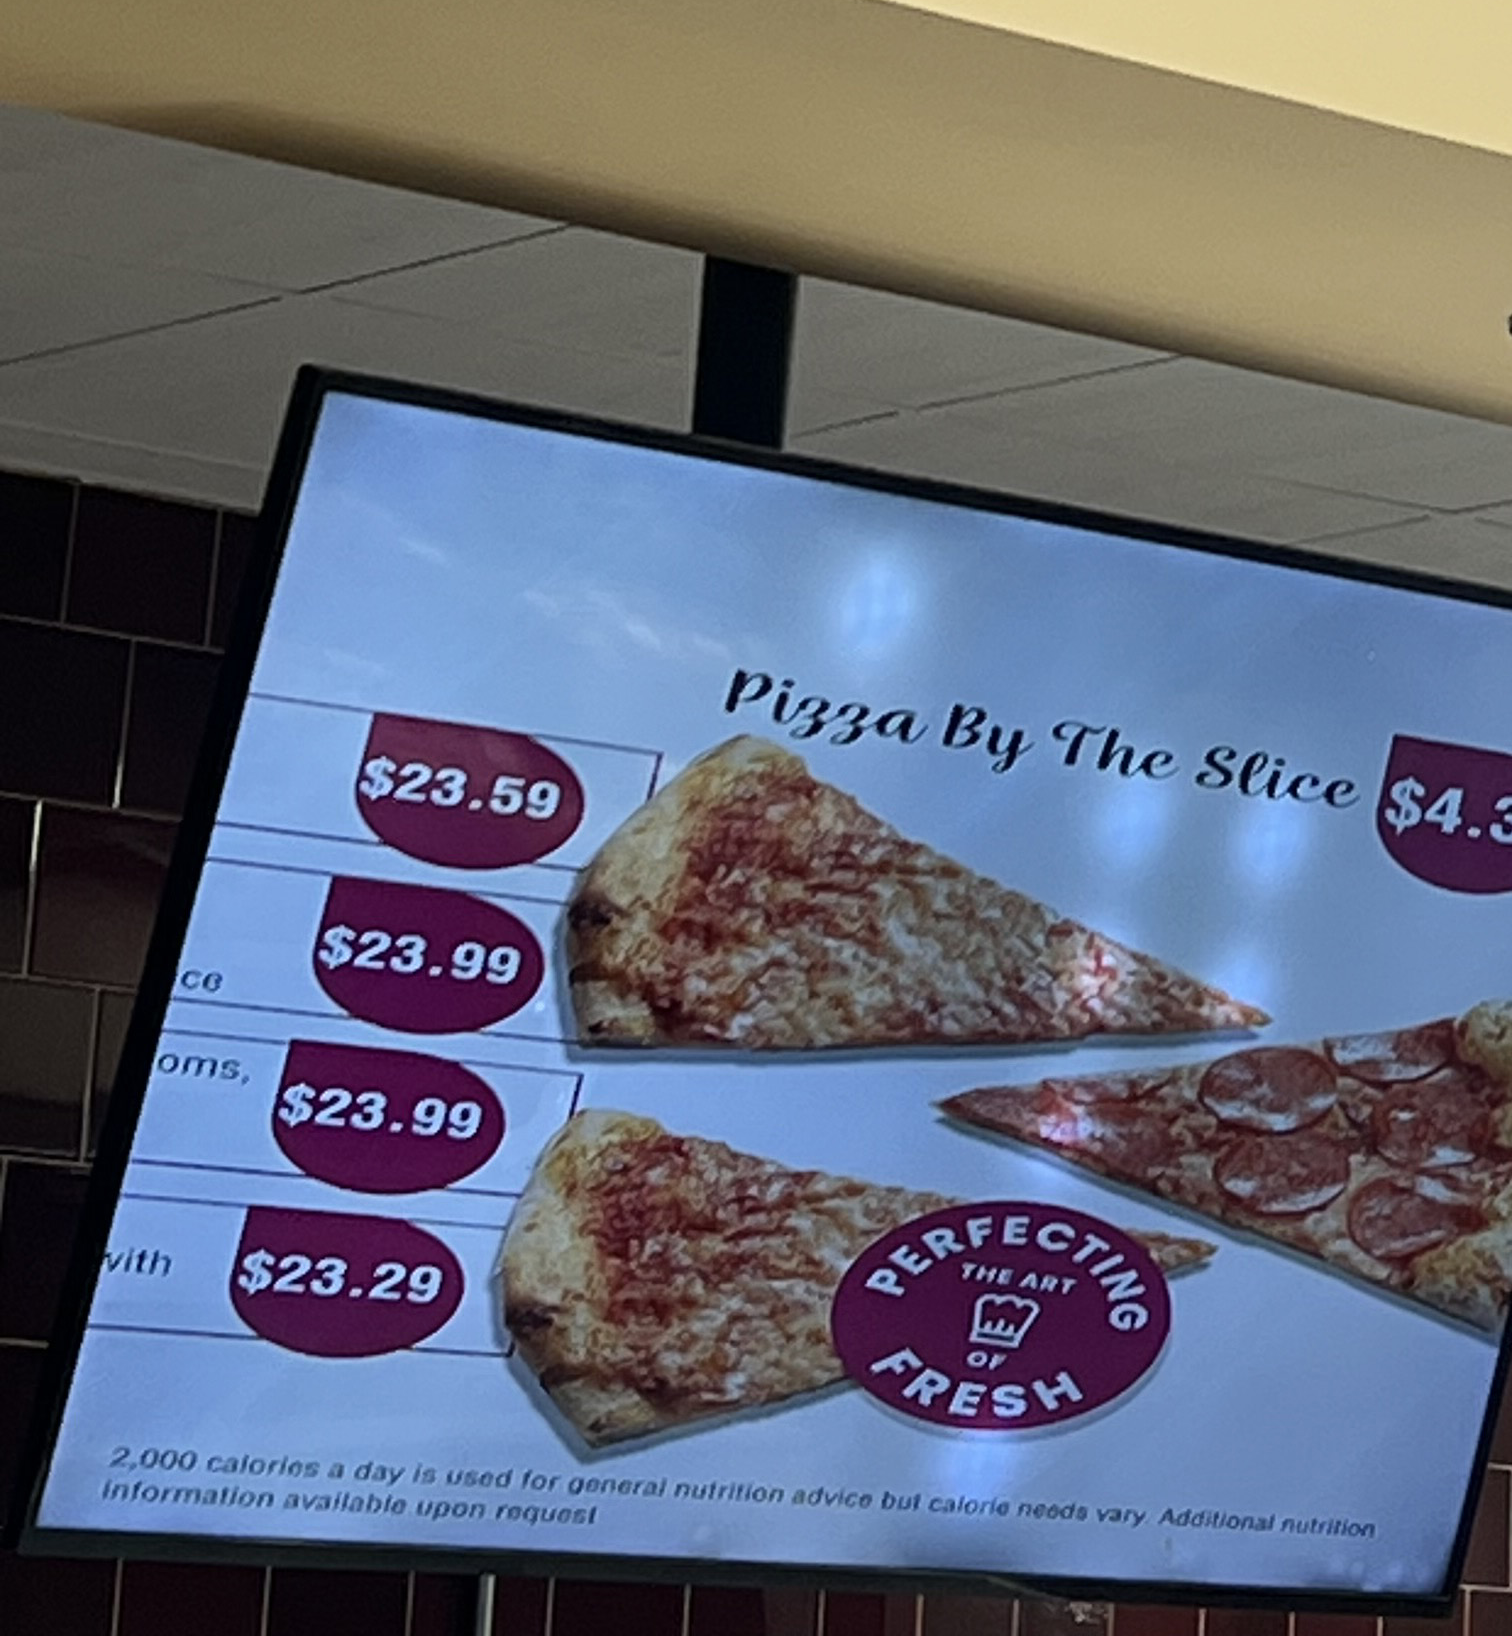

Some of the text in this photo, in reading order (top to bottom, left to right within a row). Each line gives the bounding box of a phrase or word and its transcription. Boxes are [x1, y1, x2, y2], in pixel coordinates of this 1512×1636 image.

[724, 668, 1361, 809] Pizza By The Slice
[359, 755, 561, 821] $23.59
[318, 924, 522, 986] $23.99
[277, 1082, 483, 1141] $23.99
[237, 1249, 444, 1304] $23.29
[864, 1215, 1149, 1332] PERFECTING
[961, 1262, 1078, 1295] THE ART
[870, 1347, 1084, 1418] FRESH
[966, 1351, 1006, 1371] OF
[102, 1478, 598, 1528] information available upon request
[109, 1446, 199, 1472] 2,000
[206, 1453, 319, 1480] calories
[327, 1461, 343, 1481] a
[354, 1461, 405, 1487] day
[412, 1462, 437, 1486] is
[446, 1467, 511, 1490] used
[520, 1469, 557, 1493] for
[567, 1474, 667, 1500] general
[673, 1479, 785, 1505] nutrition
[793, 1485, 872, 1510] advice
[881, 1491, 921, 1513] but
[927, 1495, 1008, 1517] calorie
[1016, 1498, 1088, 1522] needs
[1158, 1507, 1276, 1533] Additional
[1280, 1516, 1377, 1540] nutrition
